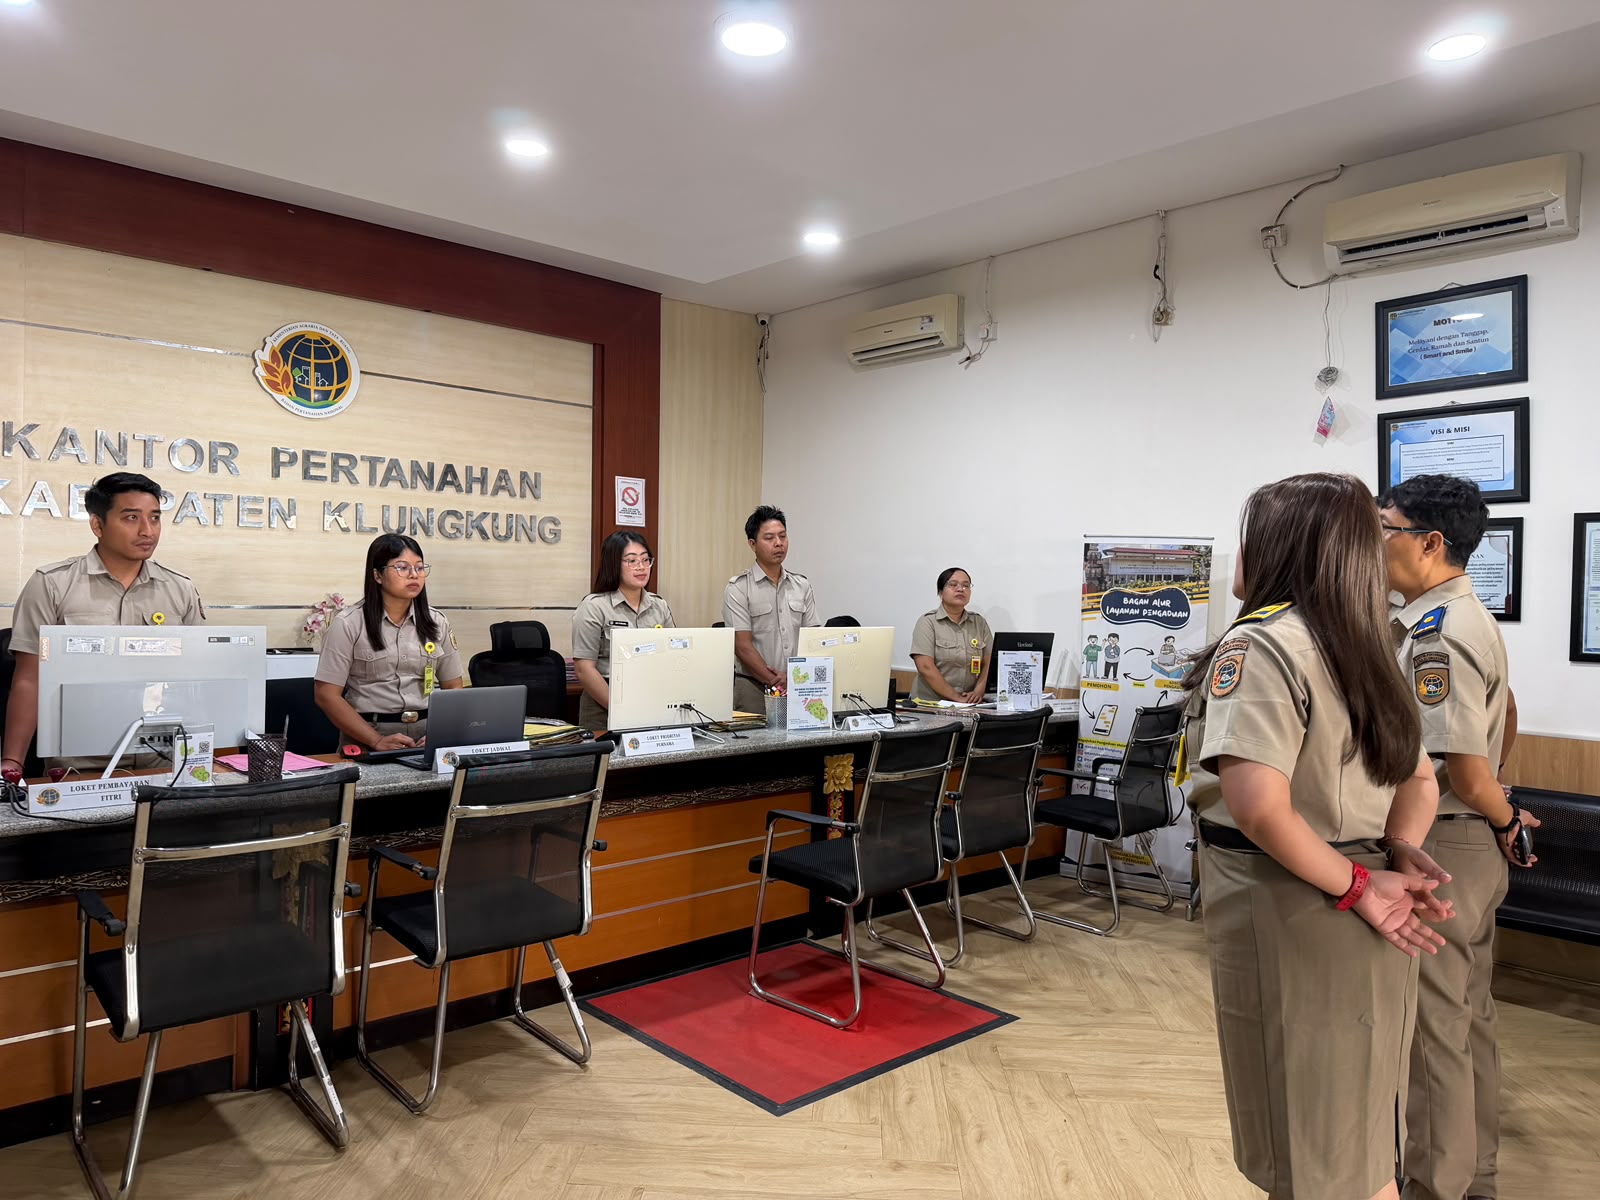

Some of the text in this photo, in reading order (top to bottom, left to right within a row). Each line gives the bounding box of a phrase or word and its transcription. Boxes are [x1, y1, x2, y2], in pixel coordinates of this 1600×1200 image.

[1430, 428, 1445, 436] VISI
[2, 421, 542, 499] KANTOR PERTANAHAN
[323, 500, 562, 544] KLUNGKUNG
[1122, 597, 1149, 605] BAGAN
[1106, 606, 1188, 618] LAYANAN PENGADUAN
[70, 779, 150, 792] LOKET PEMBAYARAN
